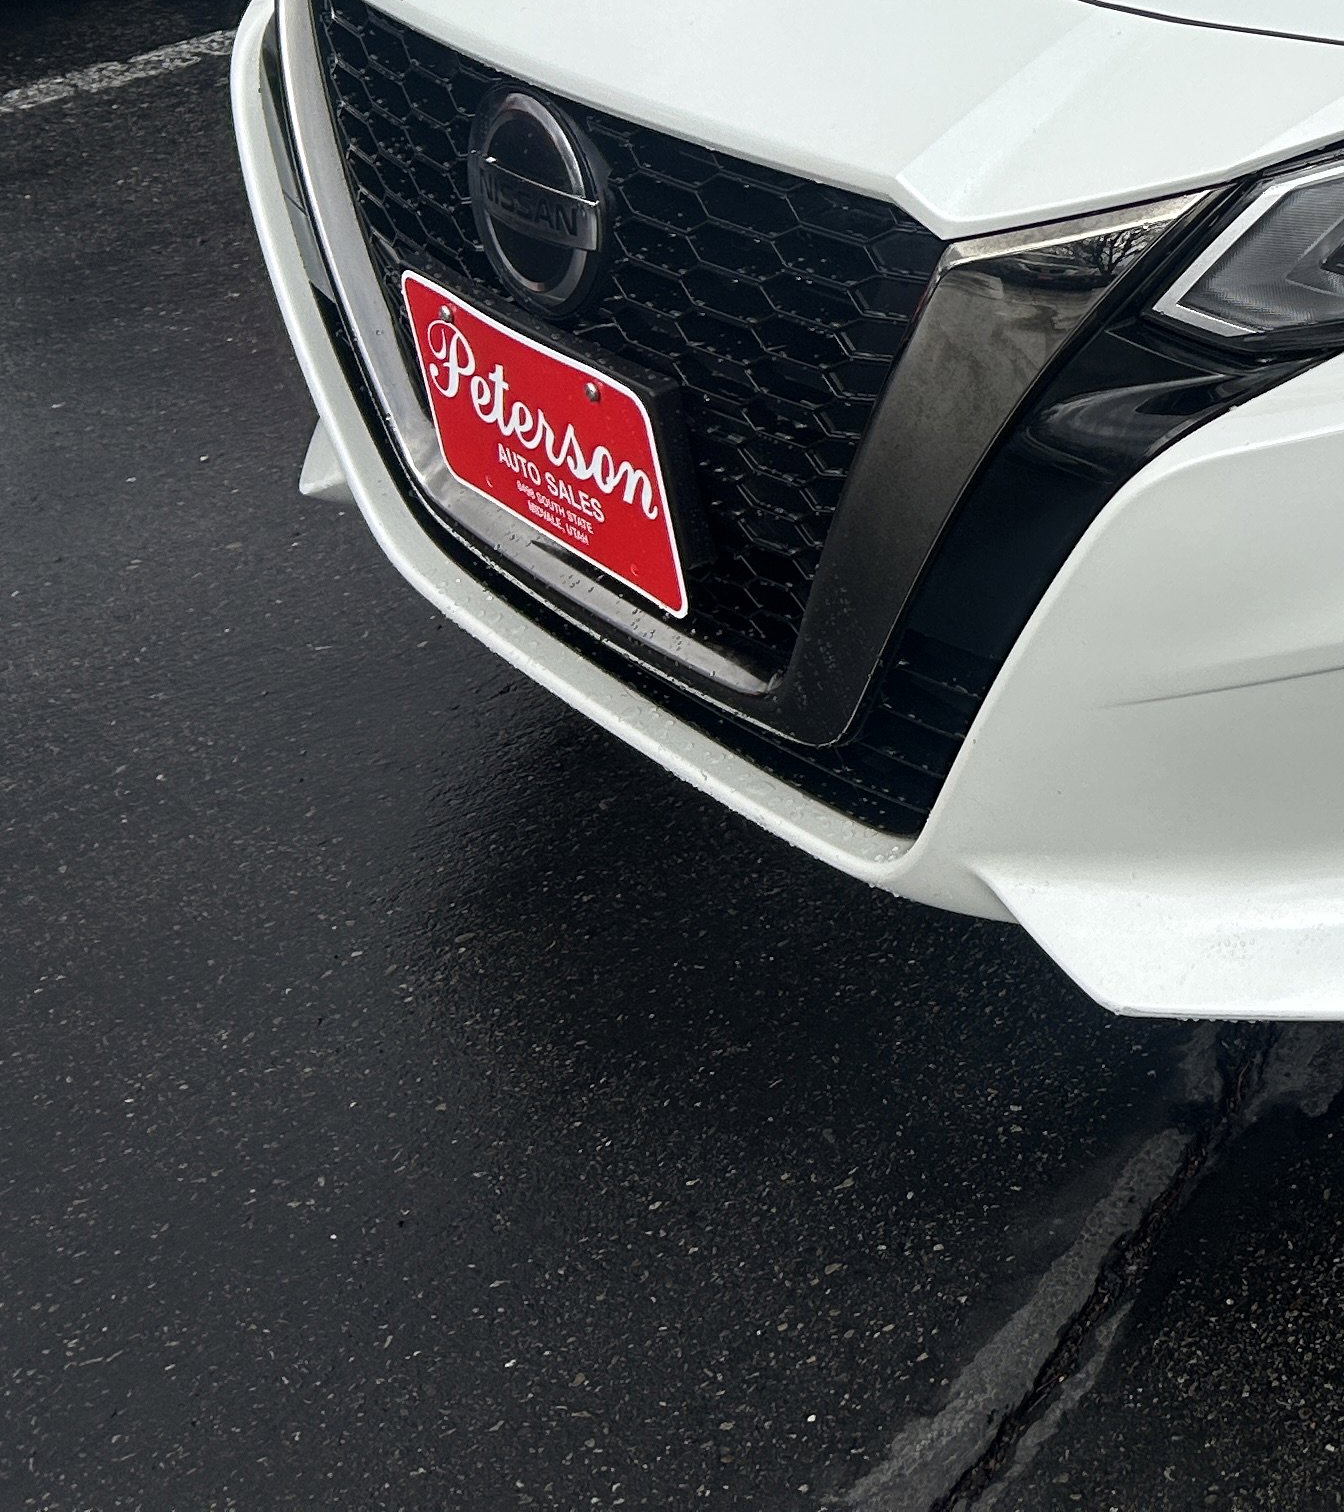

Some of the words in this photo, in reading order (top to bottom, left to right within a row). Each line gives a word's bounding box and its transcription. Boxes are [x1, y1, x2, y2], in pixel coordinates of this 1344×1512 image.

[480, 165, 578, 237] NISSAN
[427, 319, 658, 520] Peterson
[498, 443, 541, 483] AUTO
[546, 472, 605, 523] SALES
[535, 491, 565, 518] SOUTH
[566, 509, 594, 535] STATE
[565, 522, 590, 546] UTAH
